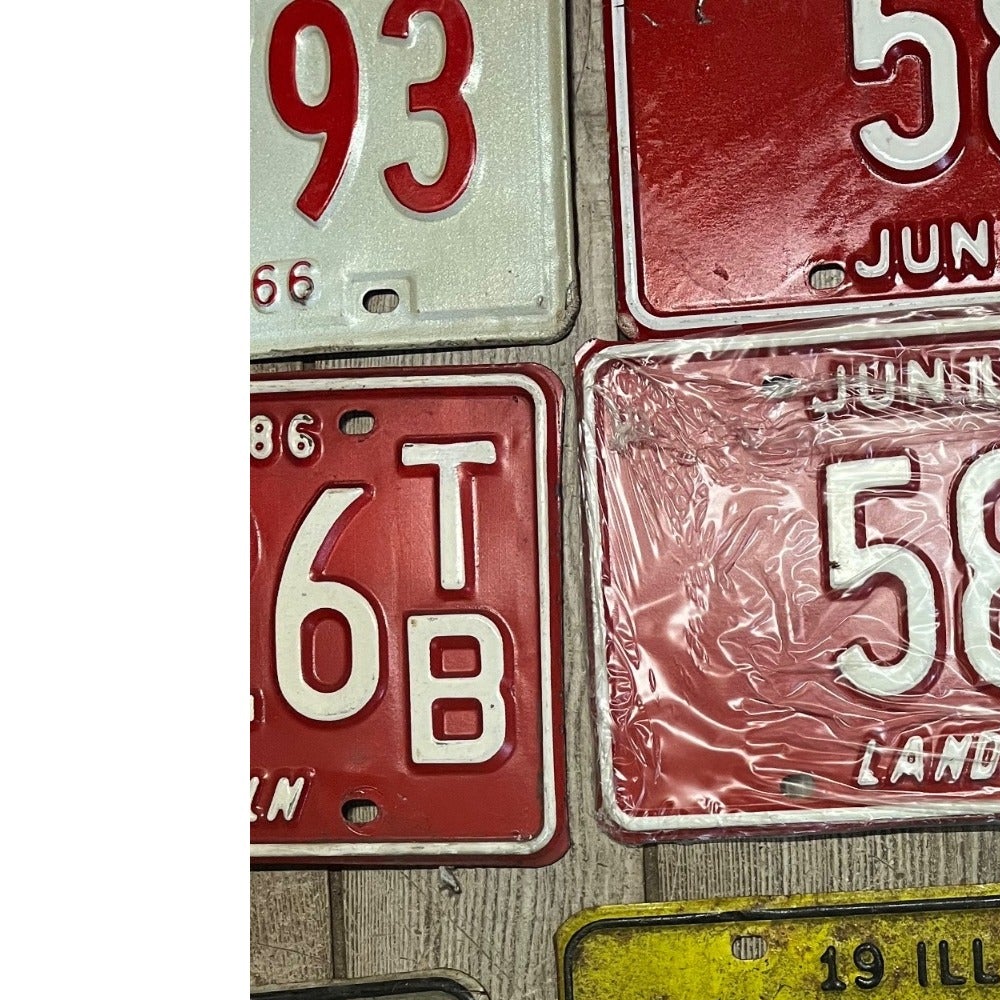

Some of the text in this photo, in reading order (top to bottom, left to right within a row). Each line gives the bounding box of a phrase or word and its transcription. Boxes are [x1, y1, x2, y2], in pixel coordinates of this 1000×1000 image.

[268, 0, 477, 222] 93
[855, 218, 989, 278] JUN
[251, 260, 315, 306] 66
[250, 413, 315, 460] 86
[250, 487, 379, 722] 6
[821, 942, 885, 991] 19
